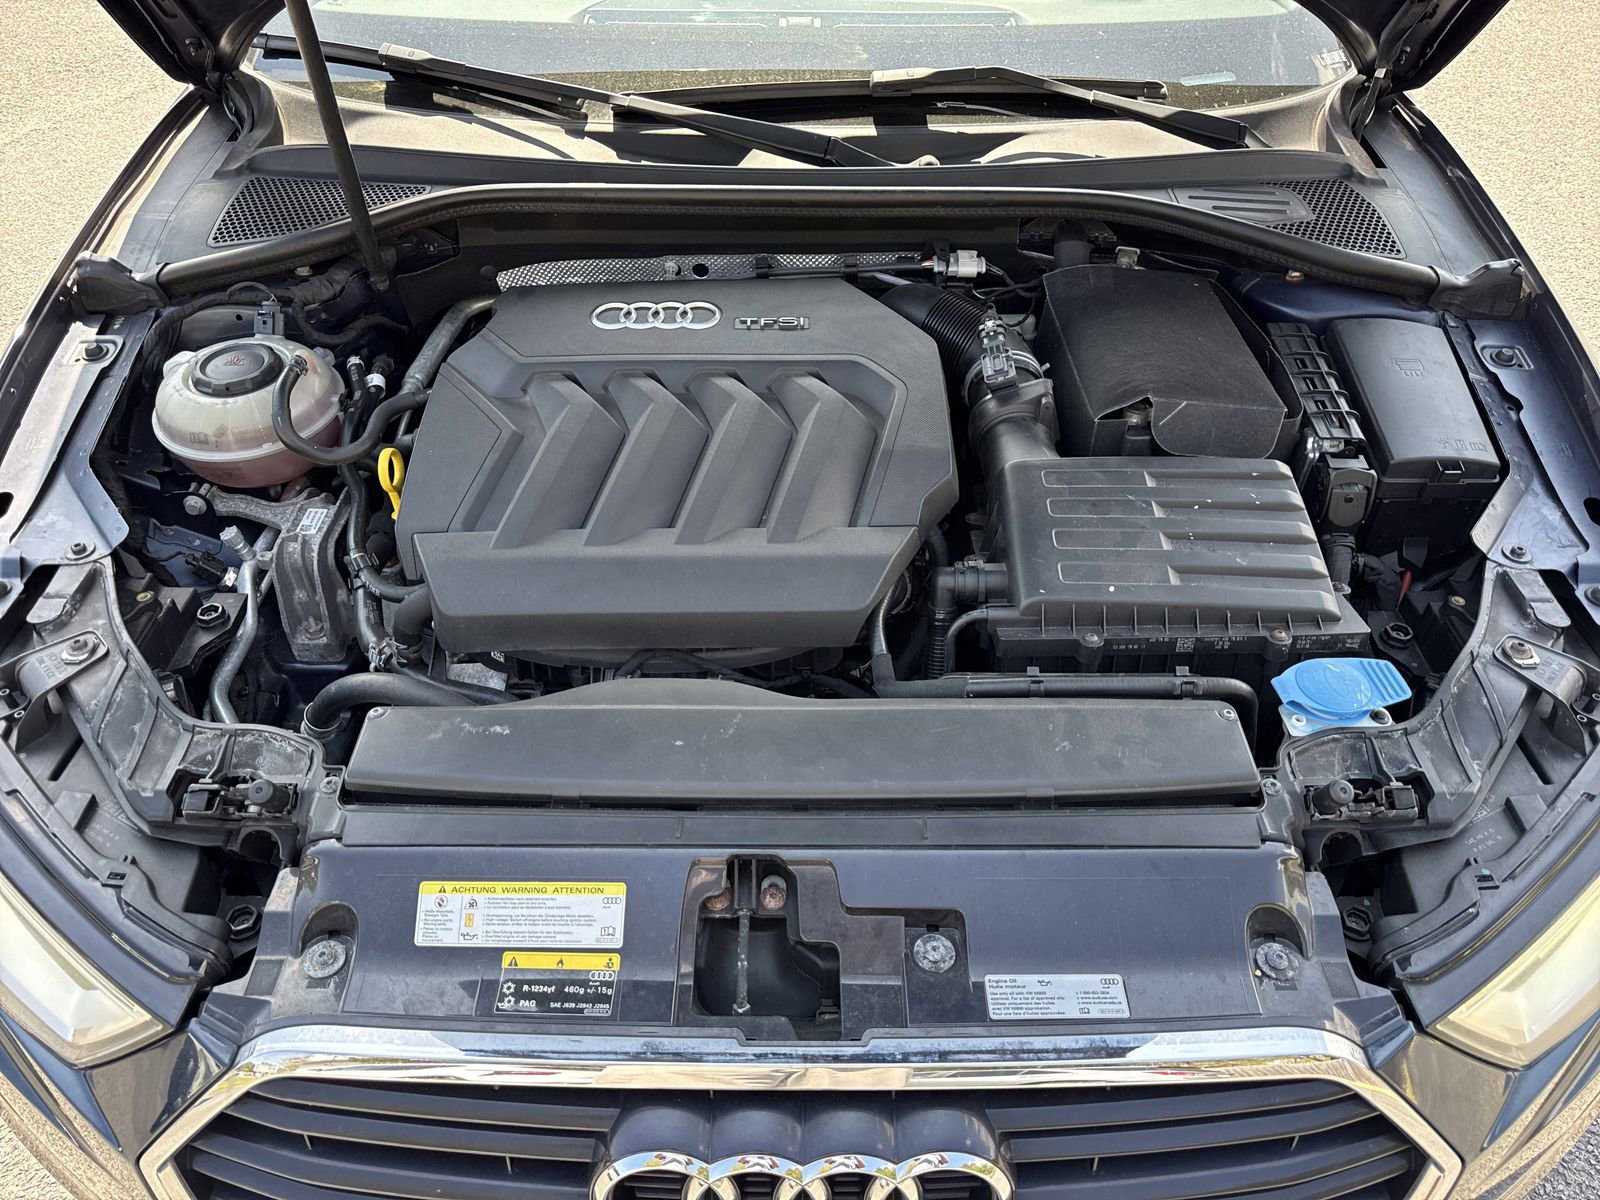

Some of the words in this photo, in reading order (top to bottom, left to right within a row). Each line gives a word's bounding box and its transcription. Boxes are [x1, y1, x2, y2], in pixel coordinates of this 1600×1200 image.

[739, 316, 805, 328] TFSI
[451, 886, 496, 894] ACHTUNG
[522, 984, 556, 994] R-1234yf
[564, 985, 585, 995] 460g
